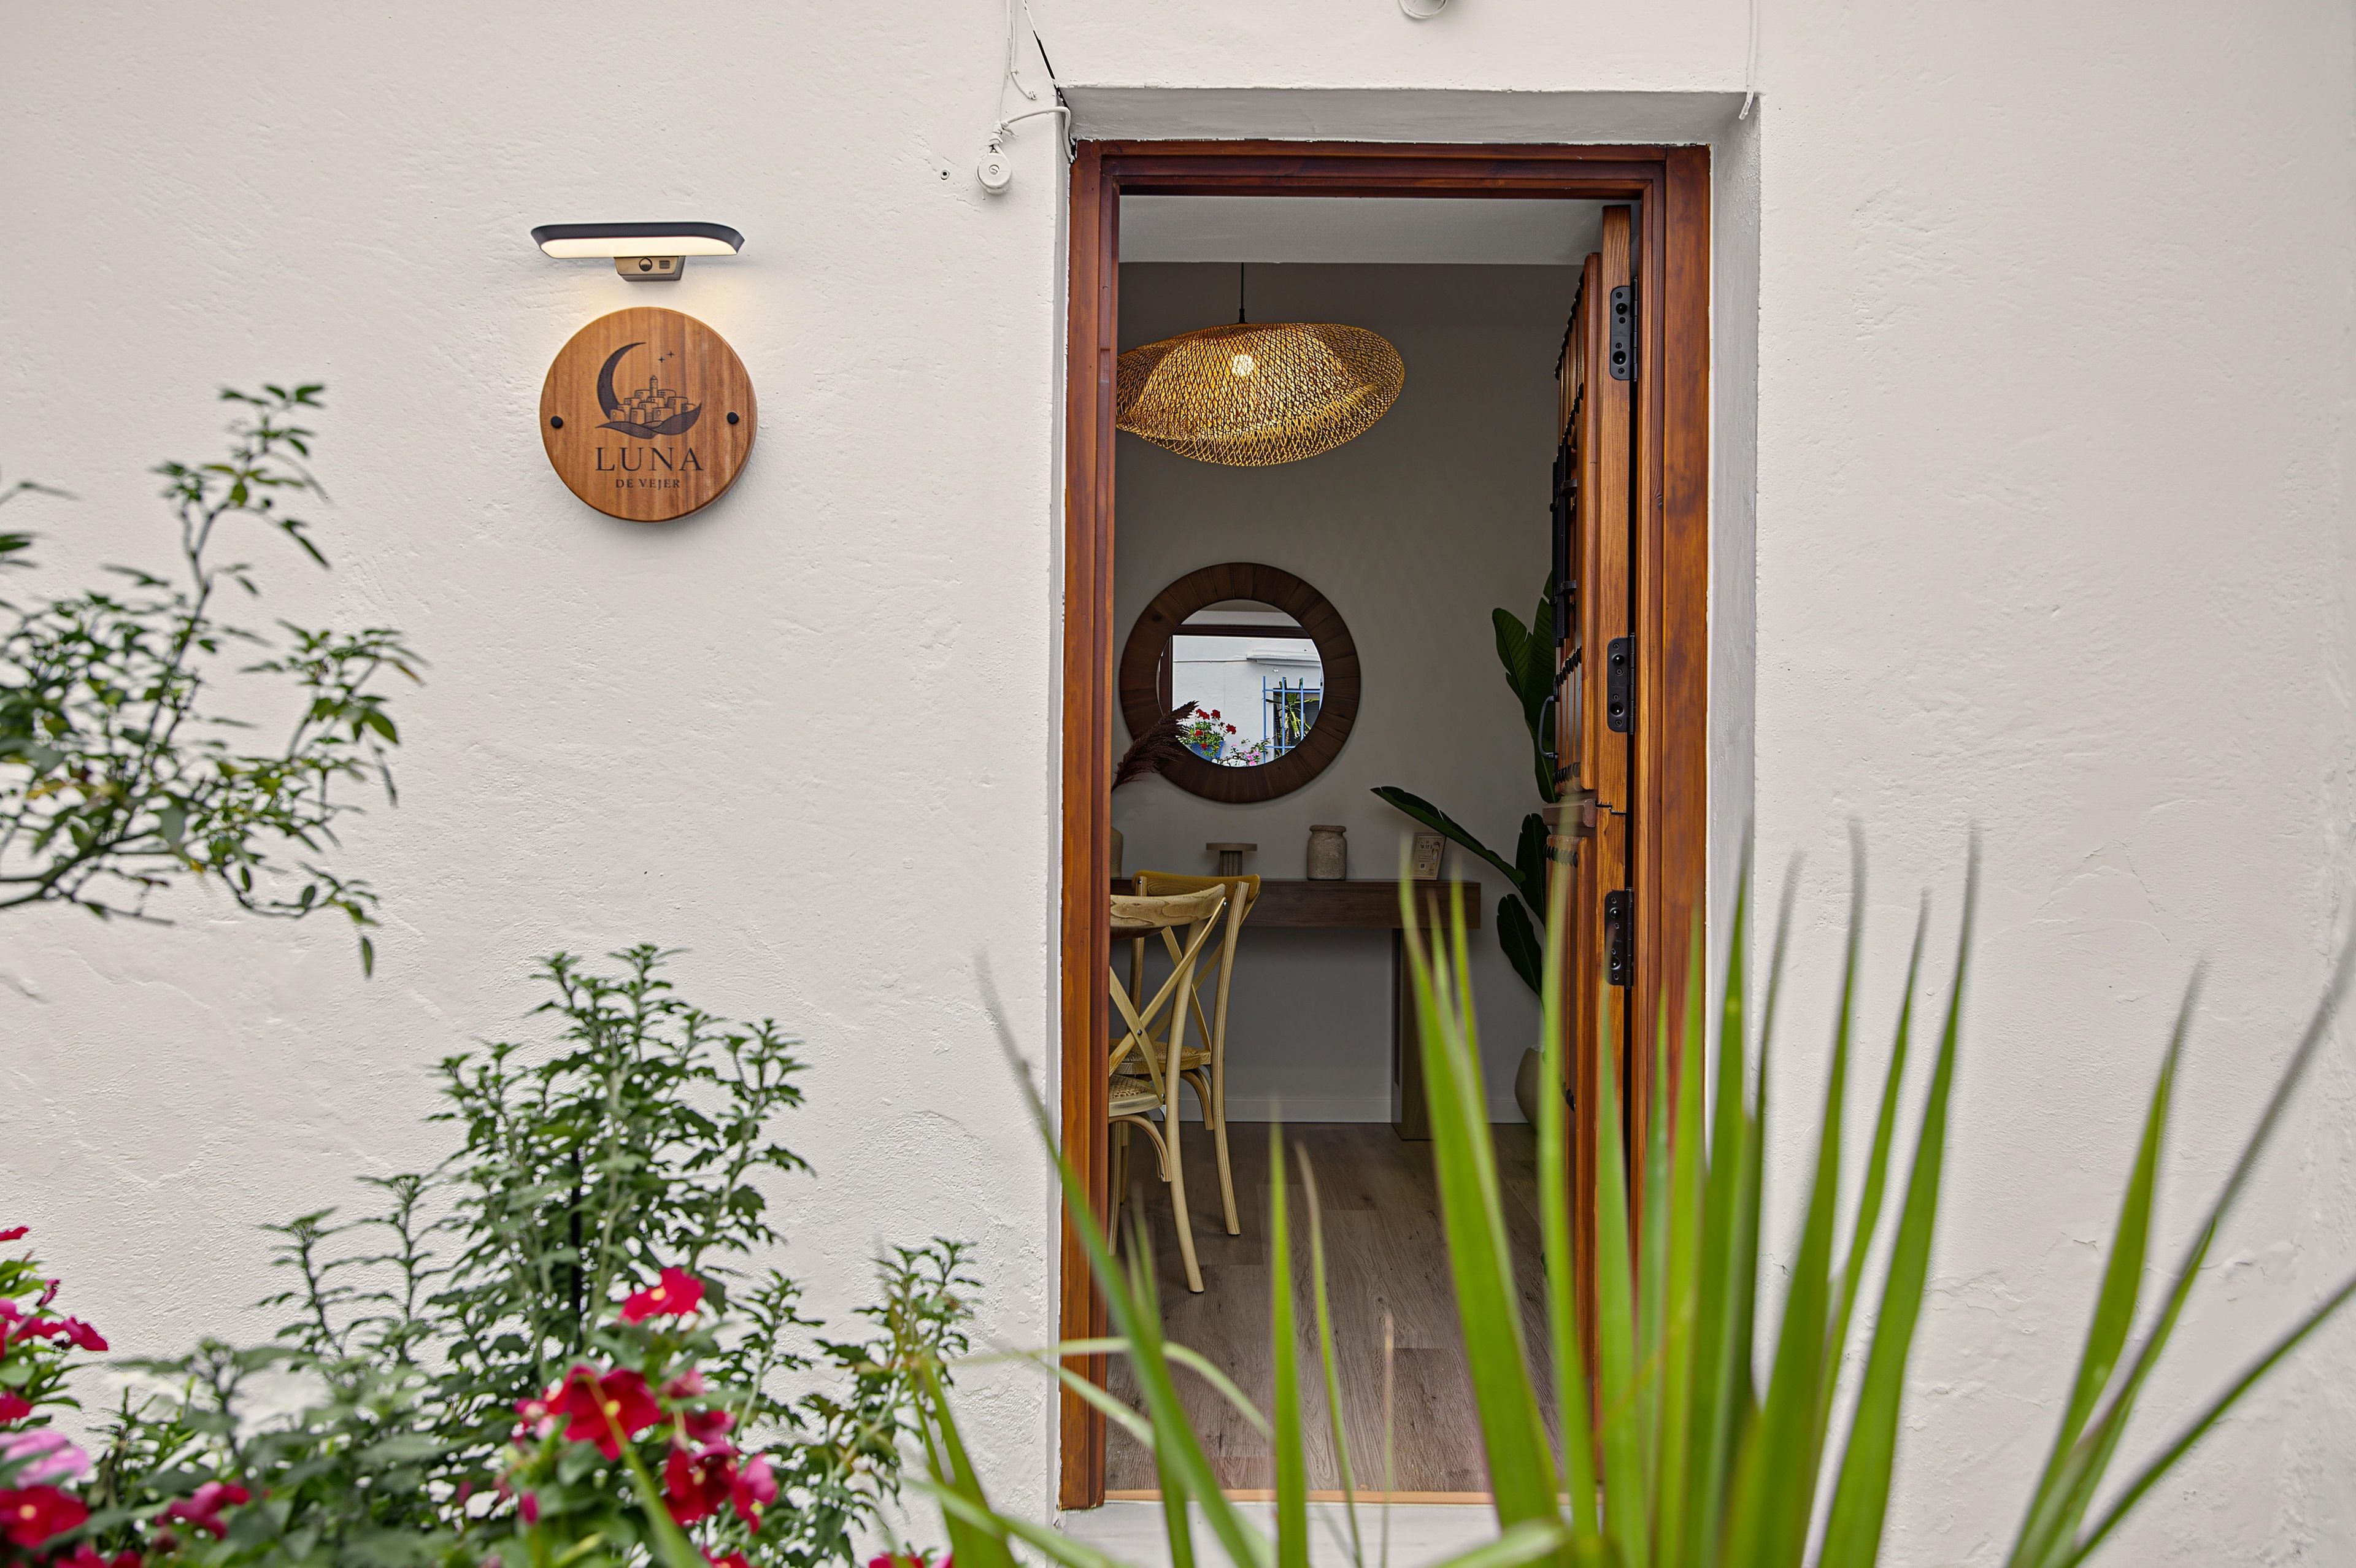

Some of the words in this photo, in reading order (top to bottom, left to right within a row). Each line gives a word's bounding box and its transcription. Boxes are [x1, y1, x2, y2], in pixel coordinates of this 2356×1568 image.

[595, 447, 704, 471] LUNA
[615, 478, 634, 488] DE
[639, 478, 680, 490] VEJER
